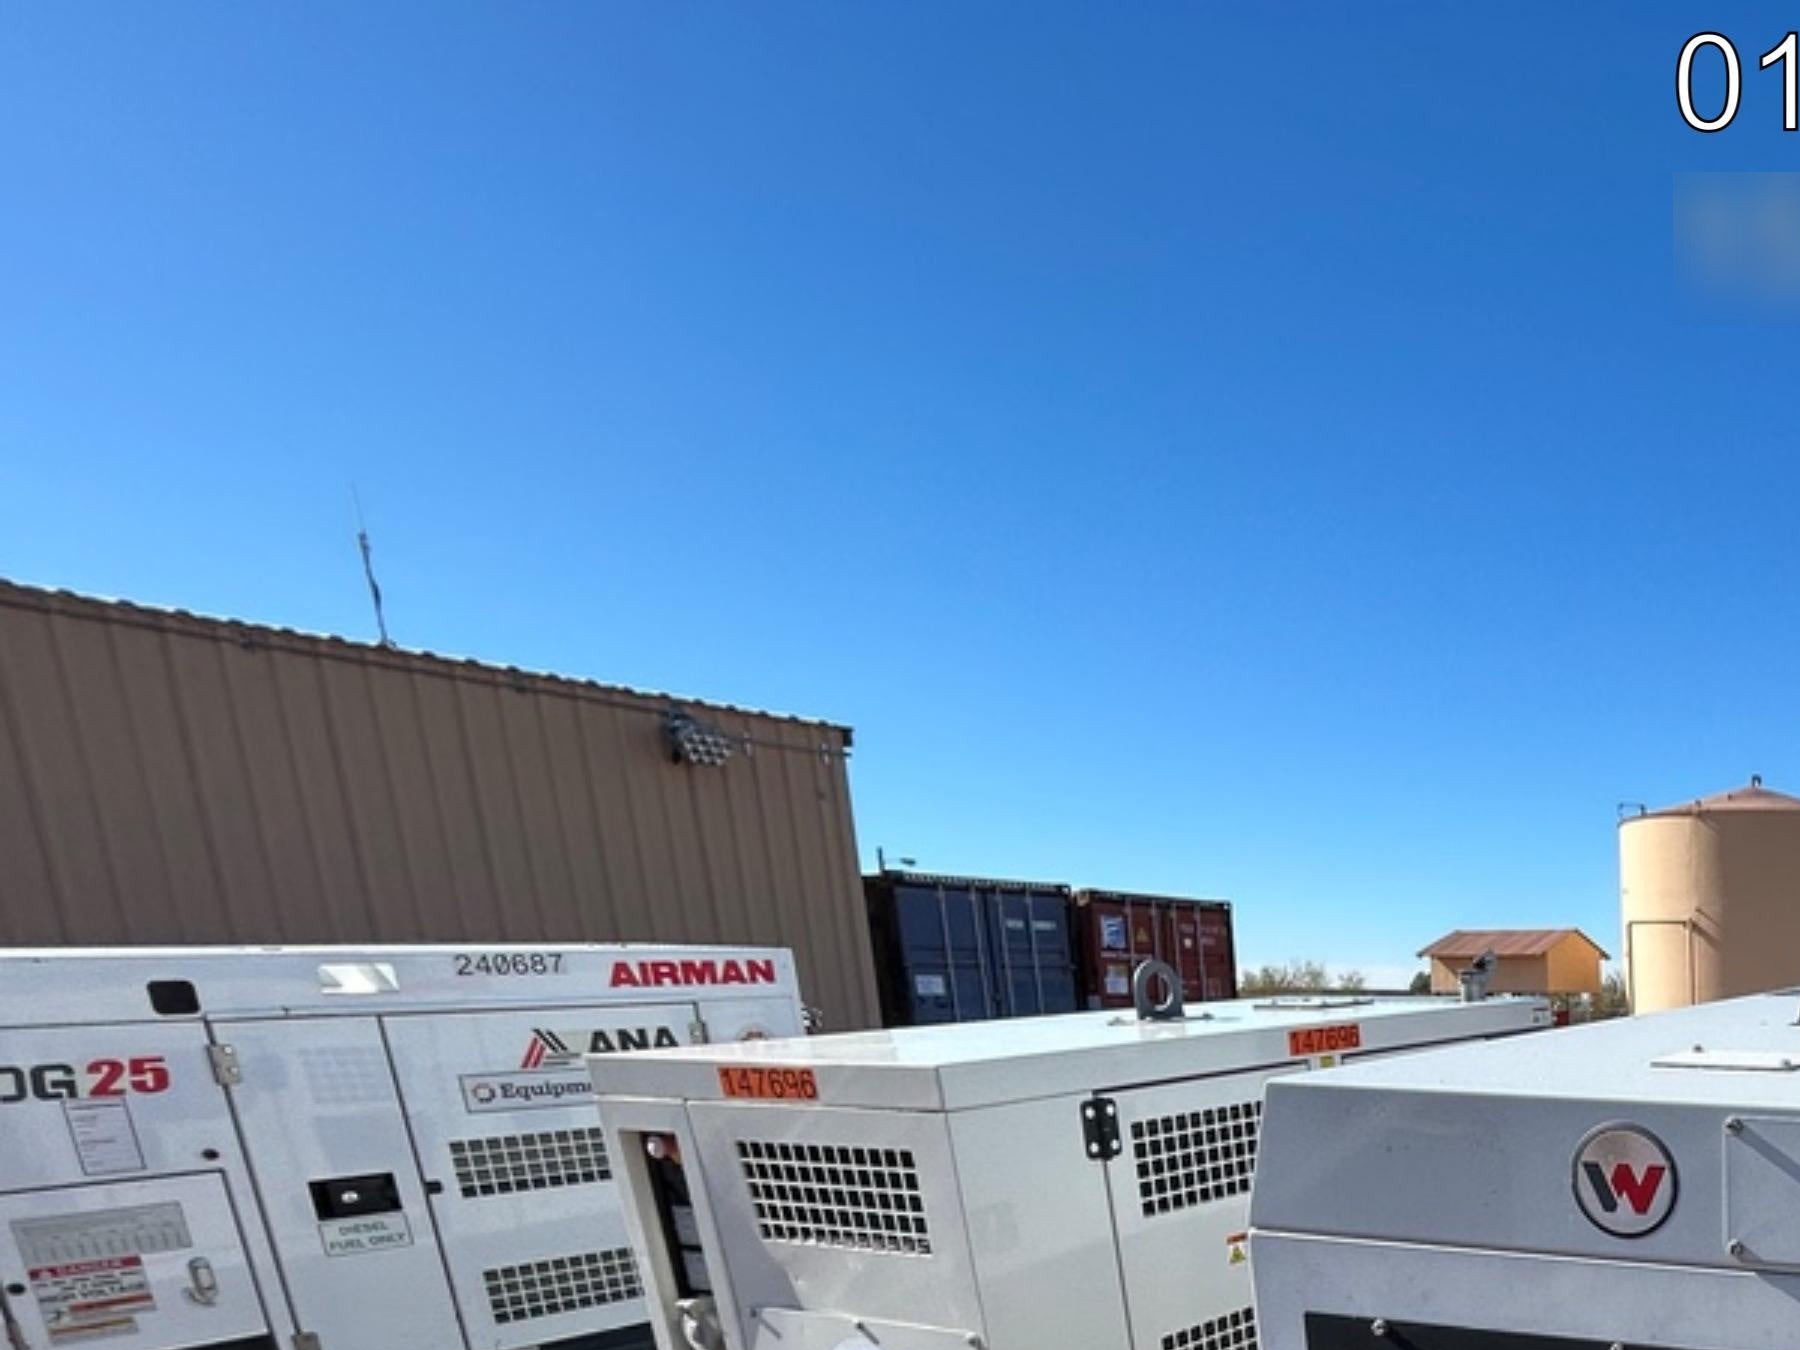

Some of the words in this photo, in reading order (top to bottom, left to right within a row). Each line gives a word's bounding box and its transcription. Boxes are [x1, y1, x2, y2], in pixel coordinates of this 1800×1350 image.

[455, 952, 562, 976] 240687
[609, 959, 776, 987] AIRMAN
[589, 1026, 679, 1053] ANA
[720, 1067, 818, 1098] 147696
[329, 1239, 366, 1250] FUEL
[369, 1231, 406, 1246] ONLY
[339, 1220, 389, 1237] DIESEL
